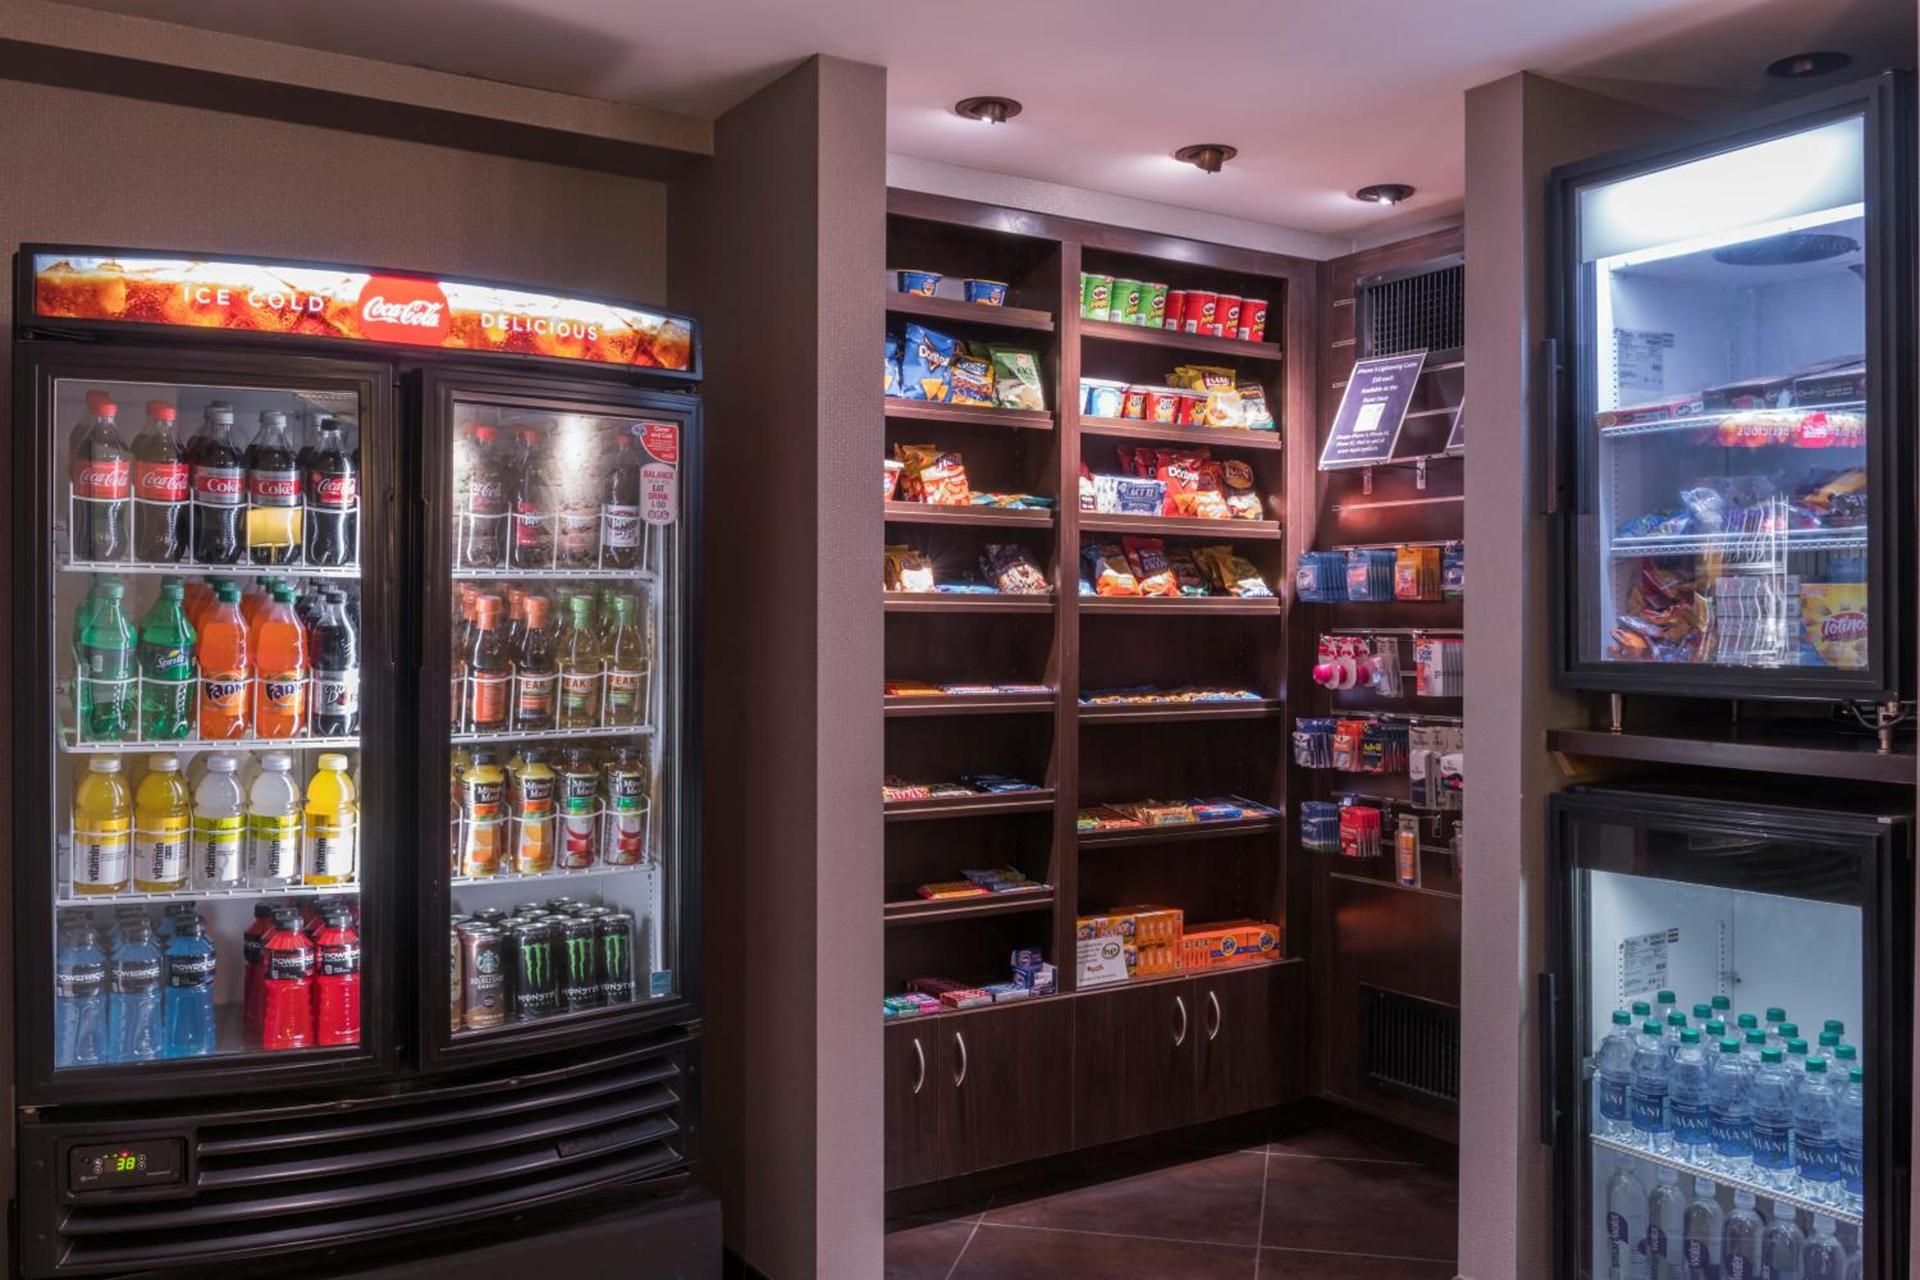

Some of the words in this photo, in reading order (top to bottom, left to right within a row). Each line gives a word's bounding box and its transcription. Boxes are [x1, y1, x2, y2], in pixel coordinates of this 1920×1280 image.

[183, 286, 231, 307] ICE
[247, 290, 325, 313] COLD
[362, 295, 441, 328] Coca-Cola
[481, 313, 598, 342] DELICIOUS
[80, 467, 128, 486] Coca-Cola
[207, 477, 241, 493] Coke
[259, 479, 296, 496] Coke
[652, 484, 664, 492] EAT
[117, 1157, 136, 1171] 38
